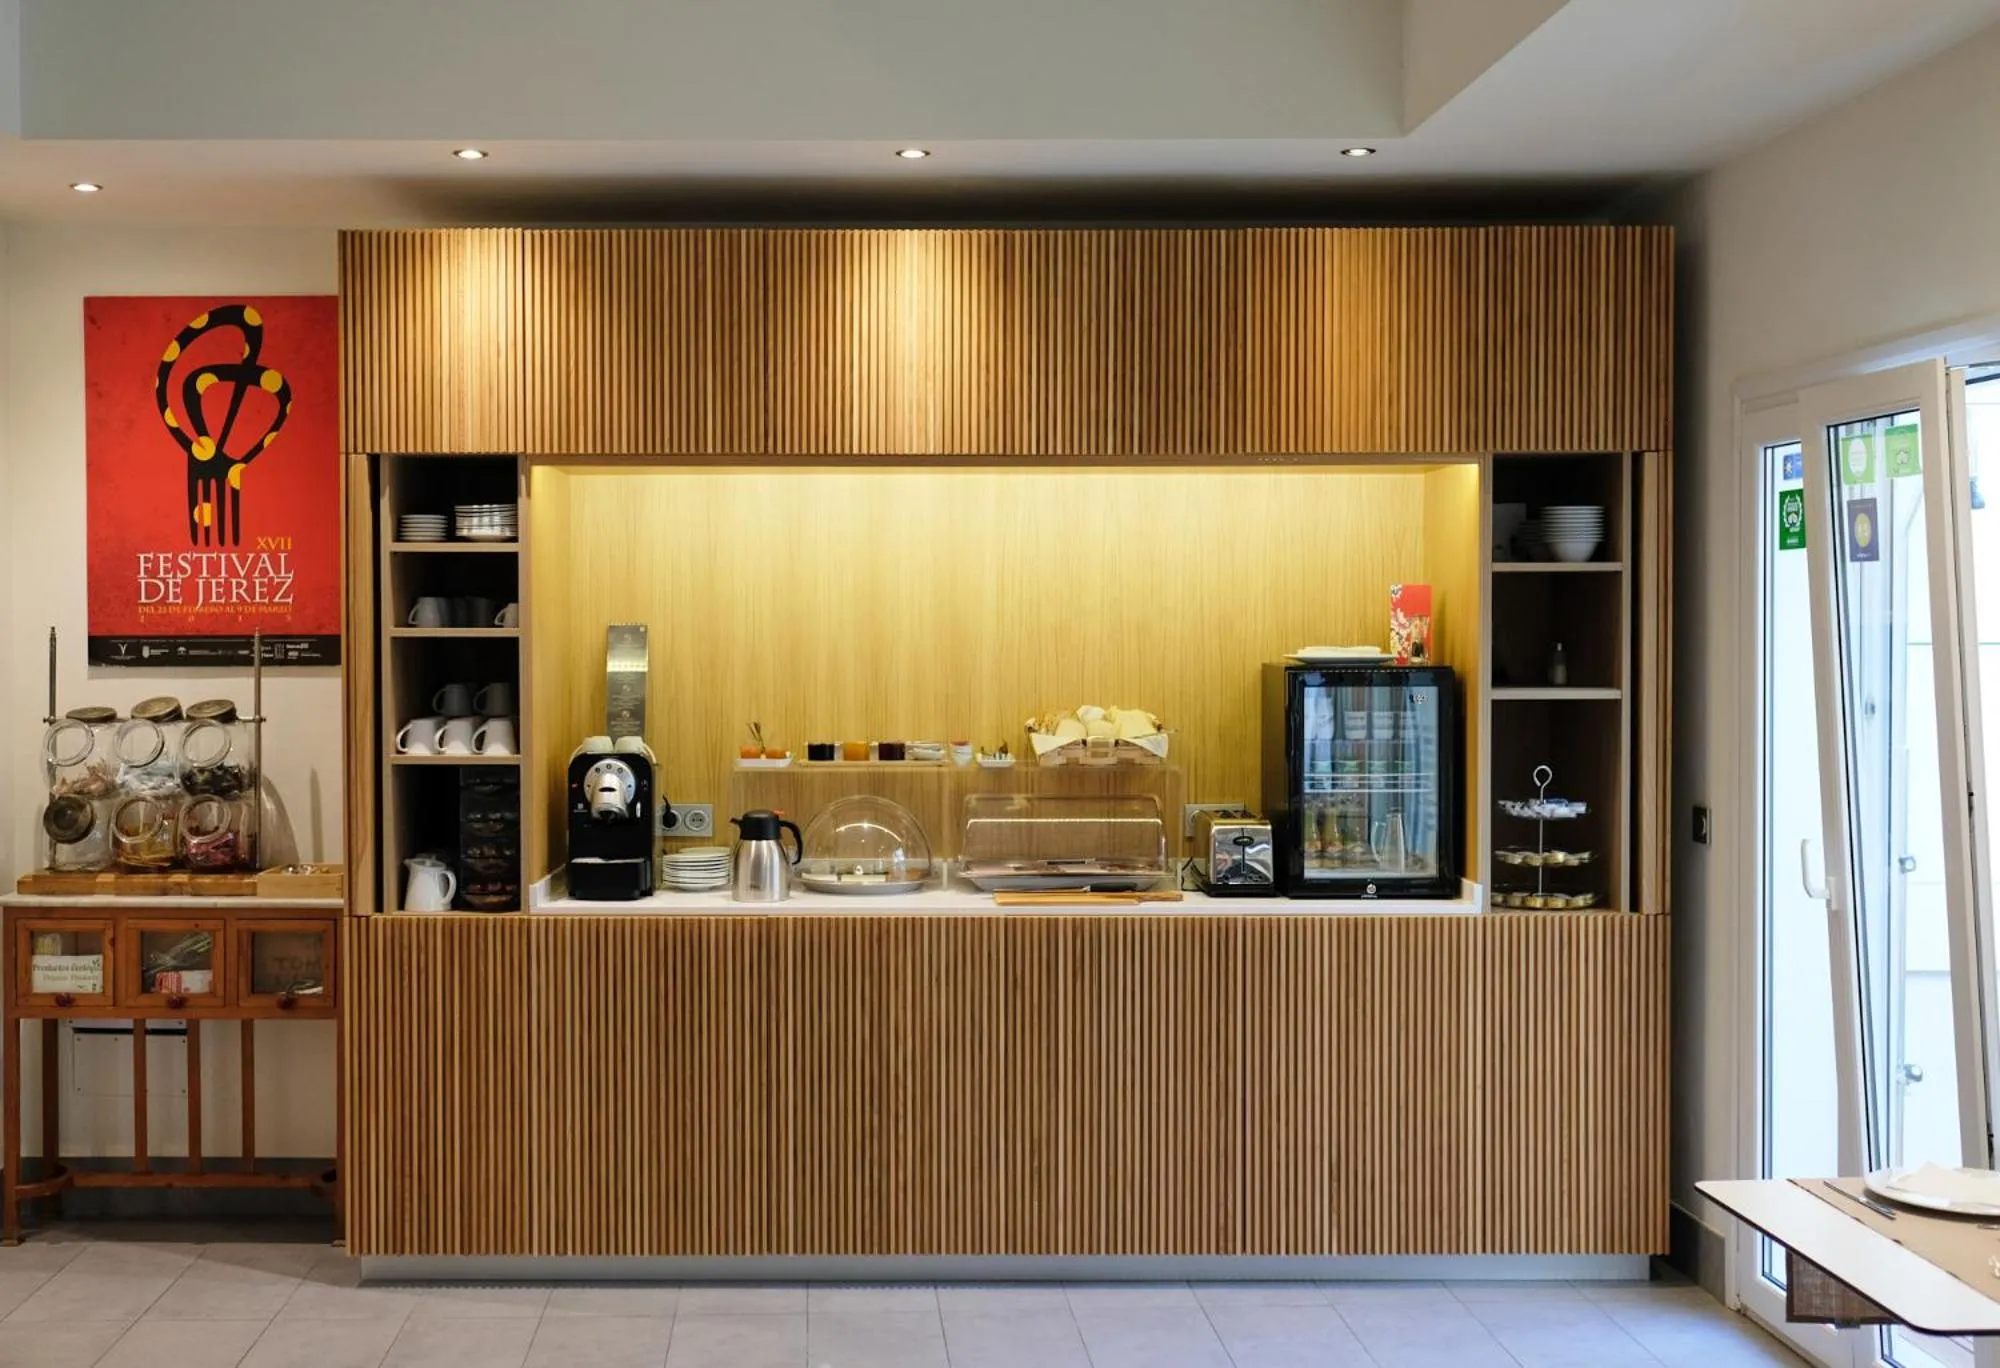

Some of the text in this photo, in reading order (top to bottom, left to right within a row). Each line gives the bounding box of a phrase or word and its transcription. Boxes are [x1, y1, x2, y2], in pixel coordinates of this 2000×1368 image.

[256, 536, 292, 550] XVII
[136, 552, 294, 578] FESTIVAL
[137, 578, 294, 609] DE JEREZ
